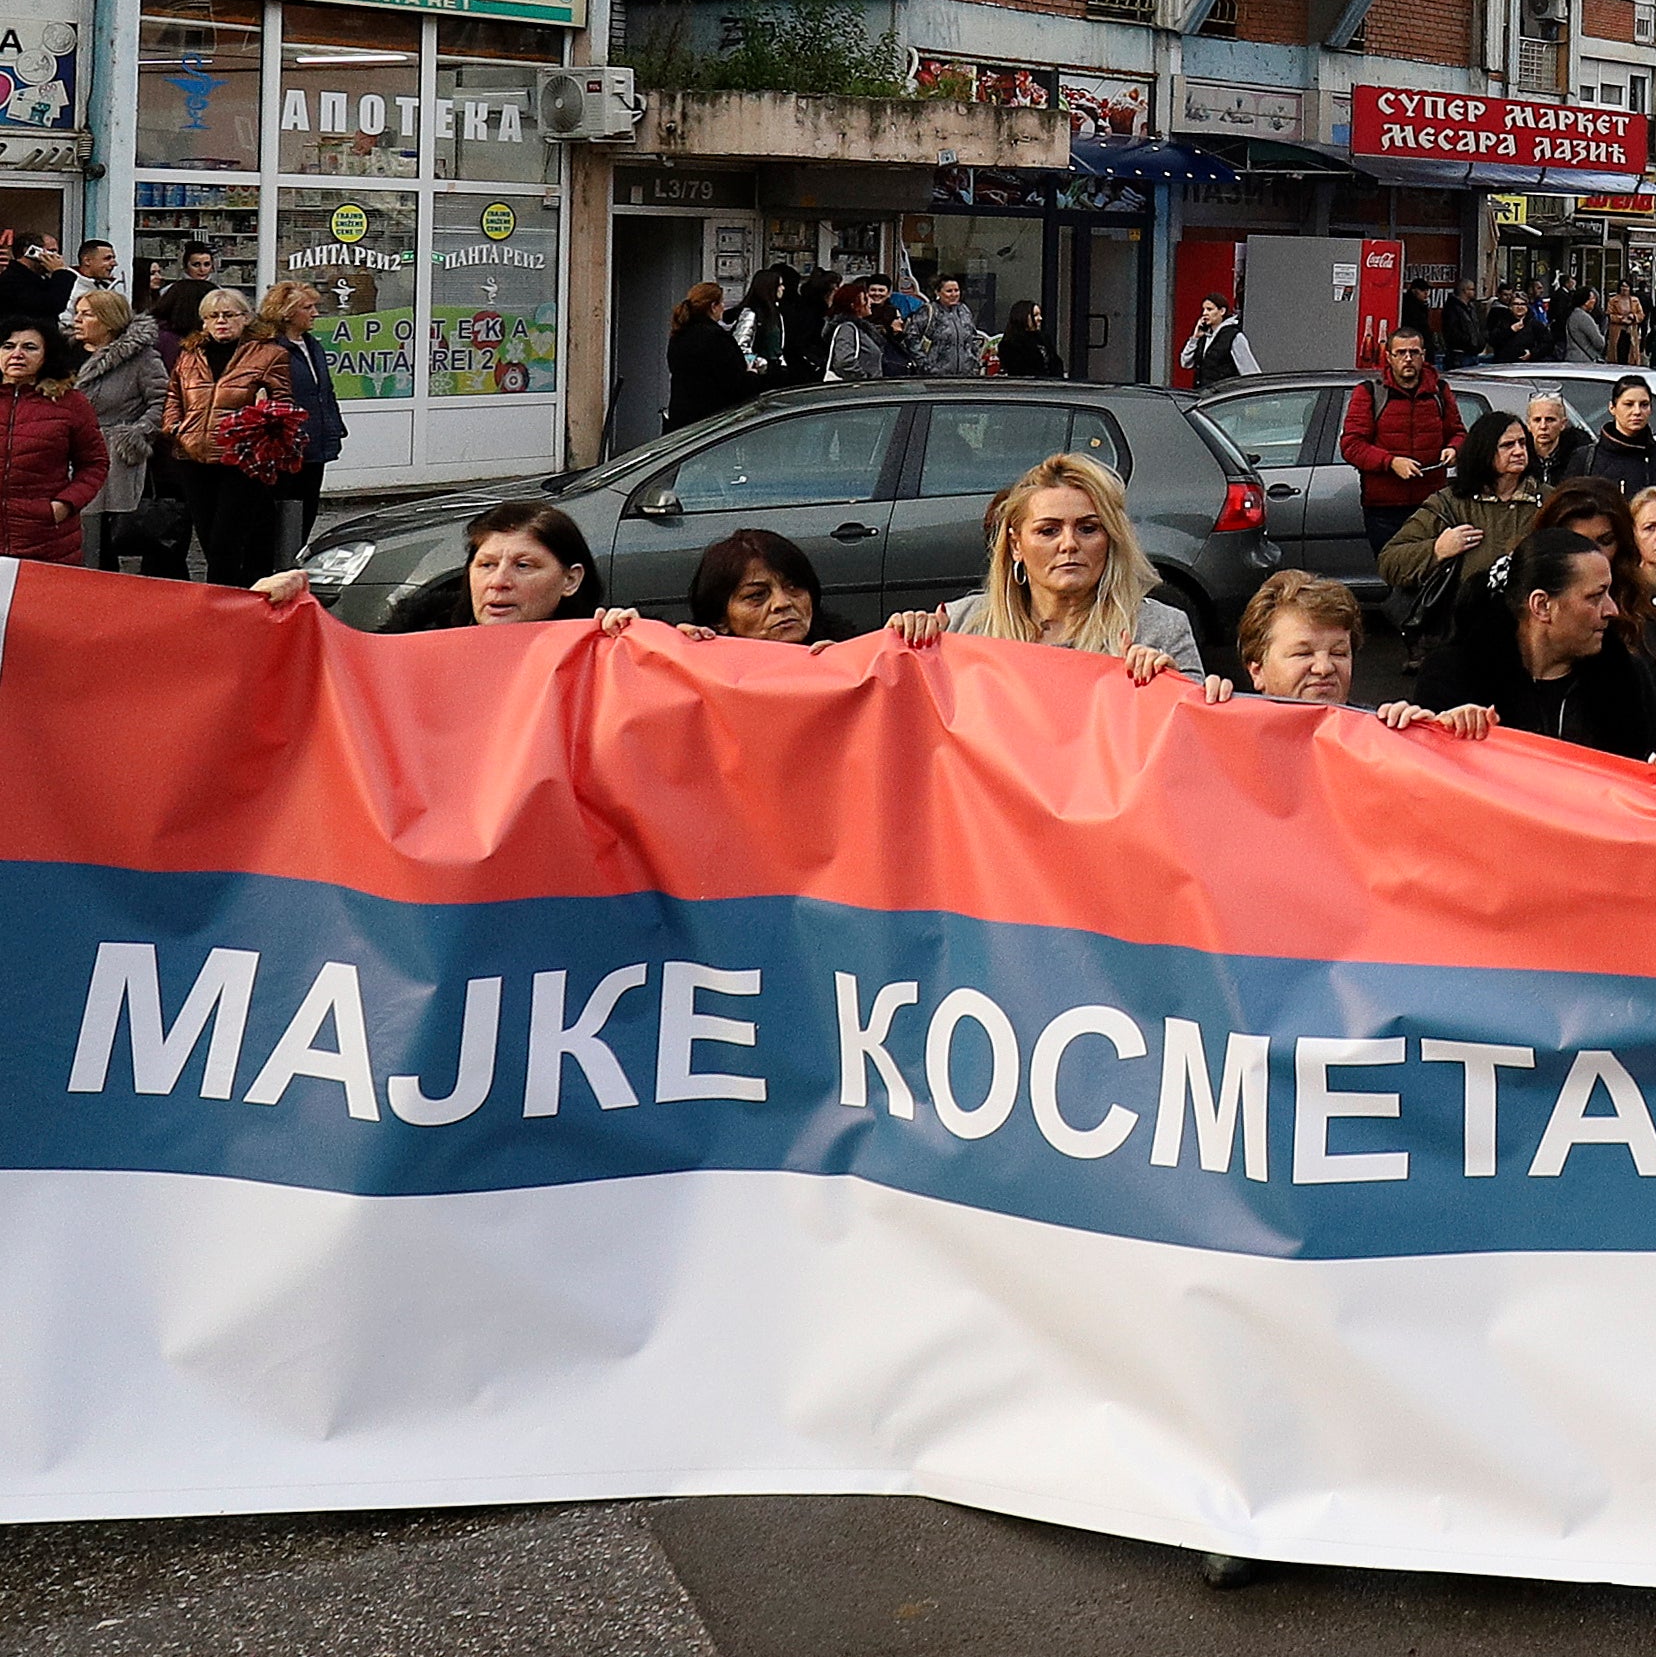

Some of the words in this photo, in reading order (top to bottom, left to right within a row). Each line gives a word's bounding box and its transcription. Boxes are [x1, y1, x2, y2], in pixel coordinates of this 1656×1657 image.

[281, 89, 523, 143] АПОТЕКА
[1377, 92, 1486, 122] СУПЕР
[1505, 104, 1630, 137] МАРКЕТ
[1381, 123, 1517, 157] МЕСАРА
[1533, 135, 1627, 165] ЛАЗИЋ
[655, 178, 713, 200] L3/79
[288, 244, 350, 271] ПАНТА
[444, 243, 499, 270] ПАНТА
[432, 348, 473, 373] REI
[66, 939, 770, 1127] МАЈКЕ
